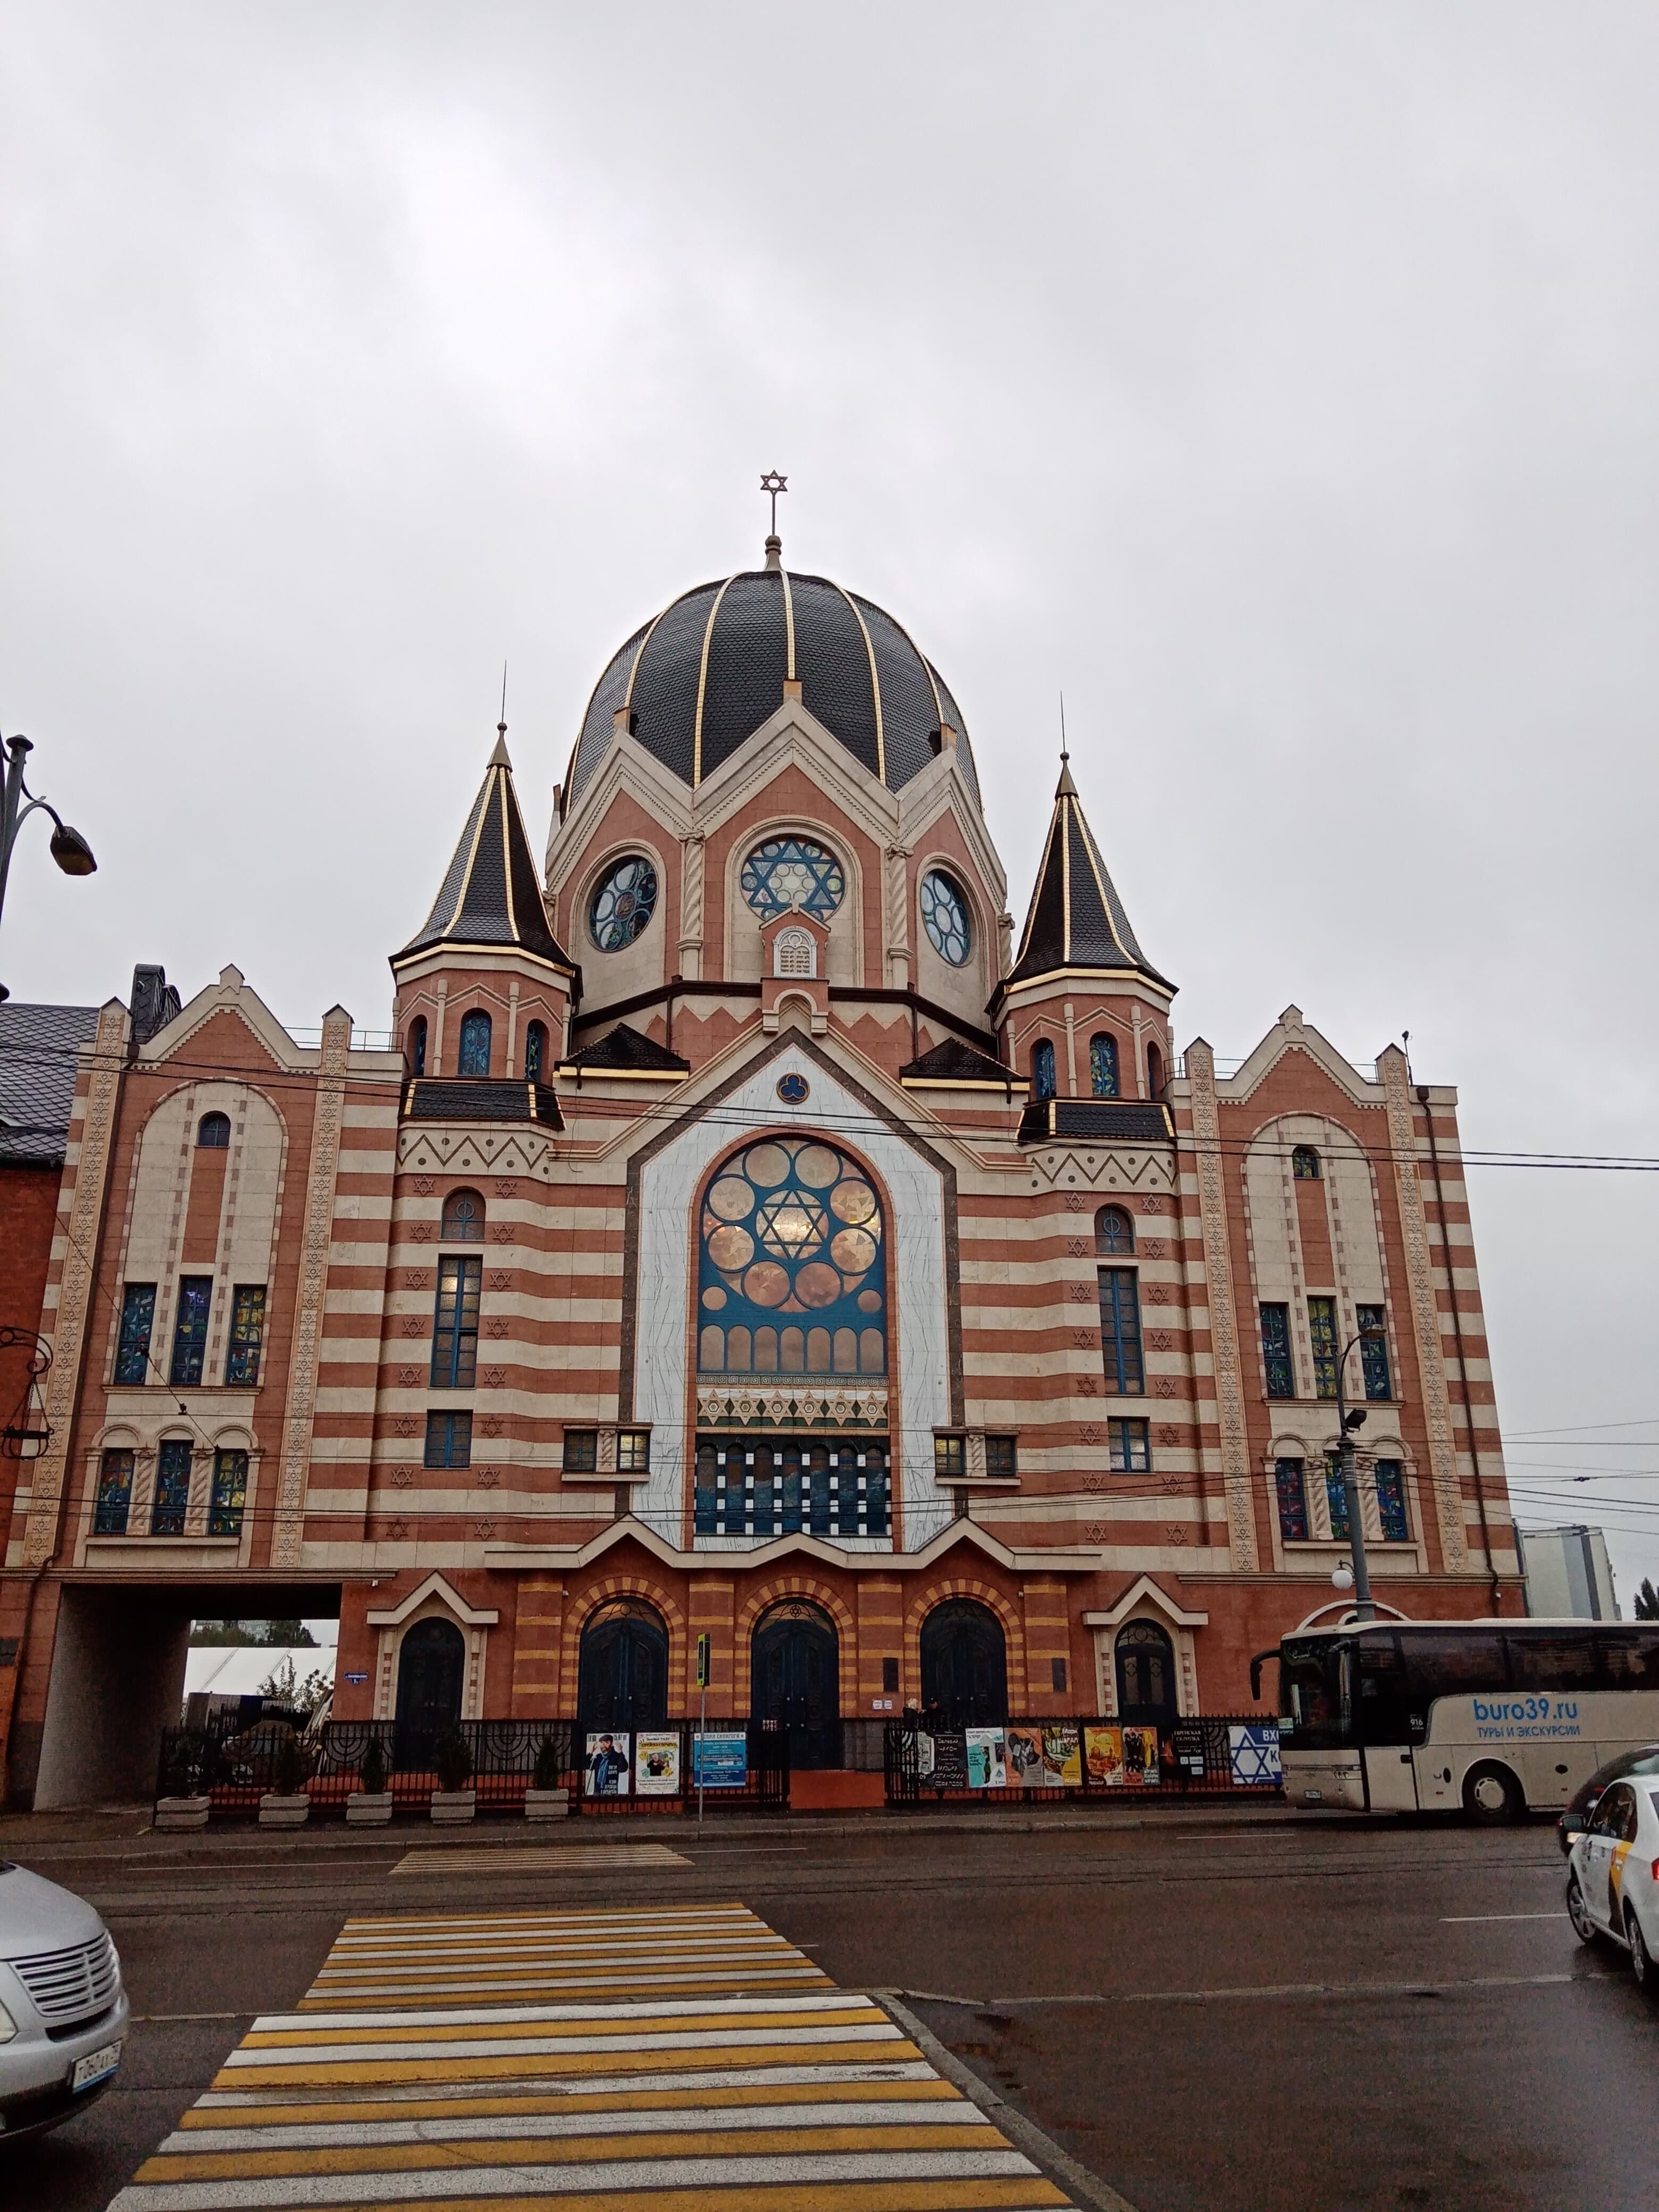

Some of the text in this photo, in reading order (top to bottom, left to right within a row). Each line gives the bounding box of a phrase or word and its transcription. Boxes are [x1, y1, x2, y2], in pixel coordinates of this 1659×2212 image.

[1473, 1698, 1578, 1721] buro39.ru
[1477, 1725, 1580, 1737] ТУРЫ И ЭКСКУРСИИ
